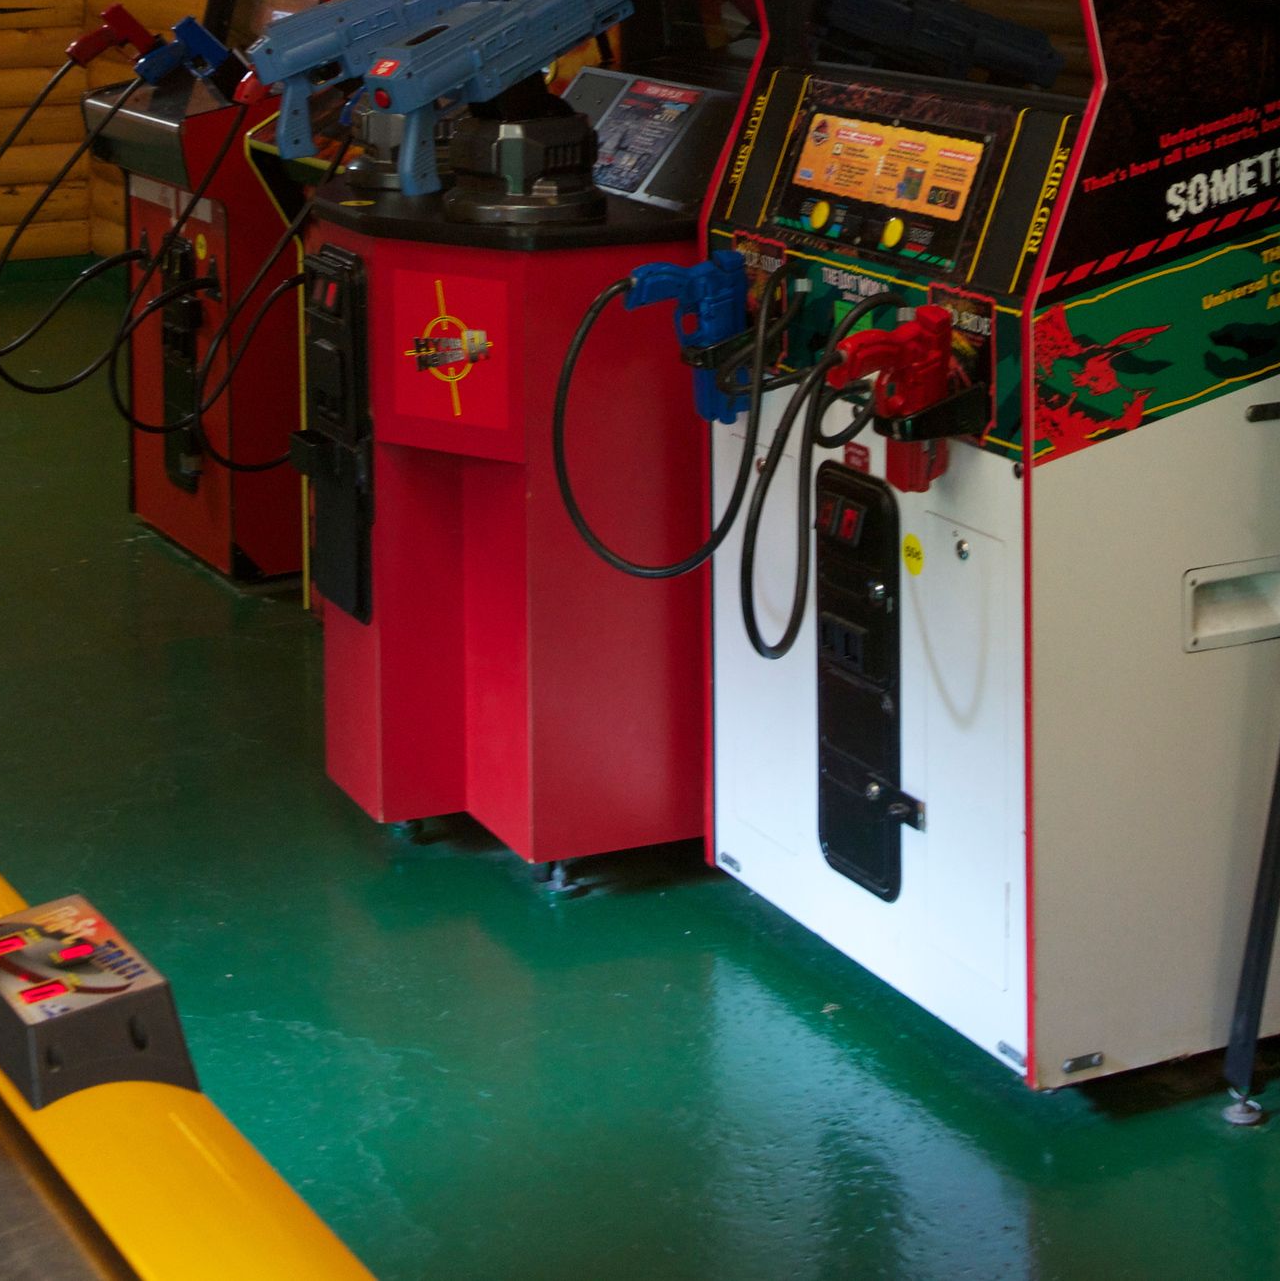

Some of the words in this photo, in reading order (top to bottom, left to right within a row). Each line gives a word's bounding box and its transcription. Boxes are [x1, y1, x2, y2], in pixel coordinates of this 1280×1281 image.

[728, 143, 754, 184] SIDE
[1082, 168, 1128, 193] That's
[1129, 158, 1162, 177] how
[1164, 148, 1183, 165] all
[1185, 139, 1211, 158] this
[1027, 206, 1051, 255] RED
[1044, 147, 1071, 200] SIDE
[1202, 274, 1268, 310] Universal
